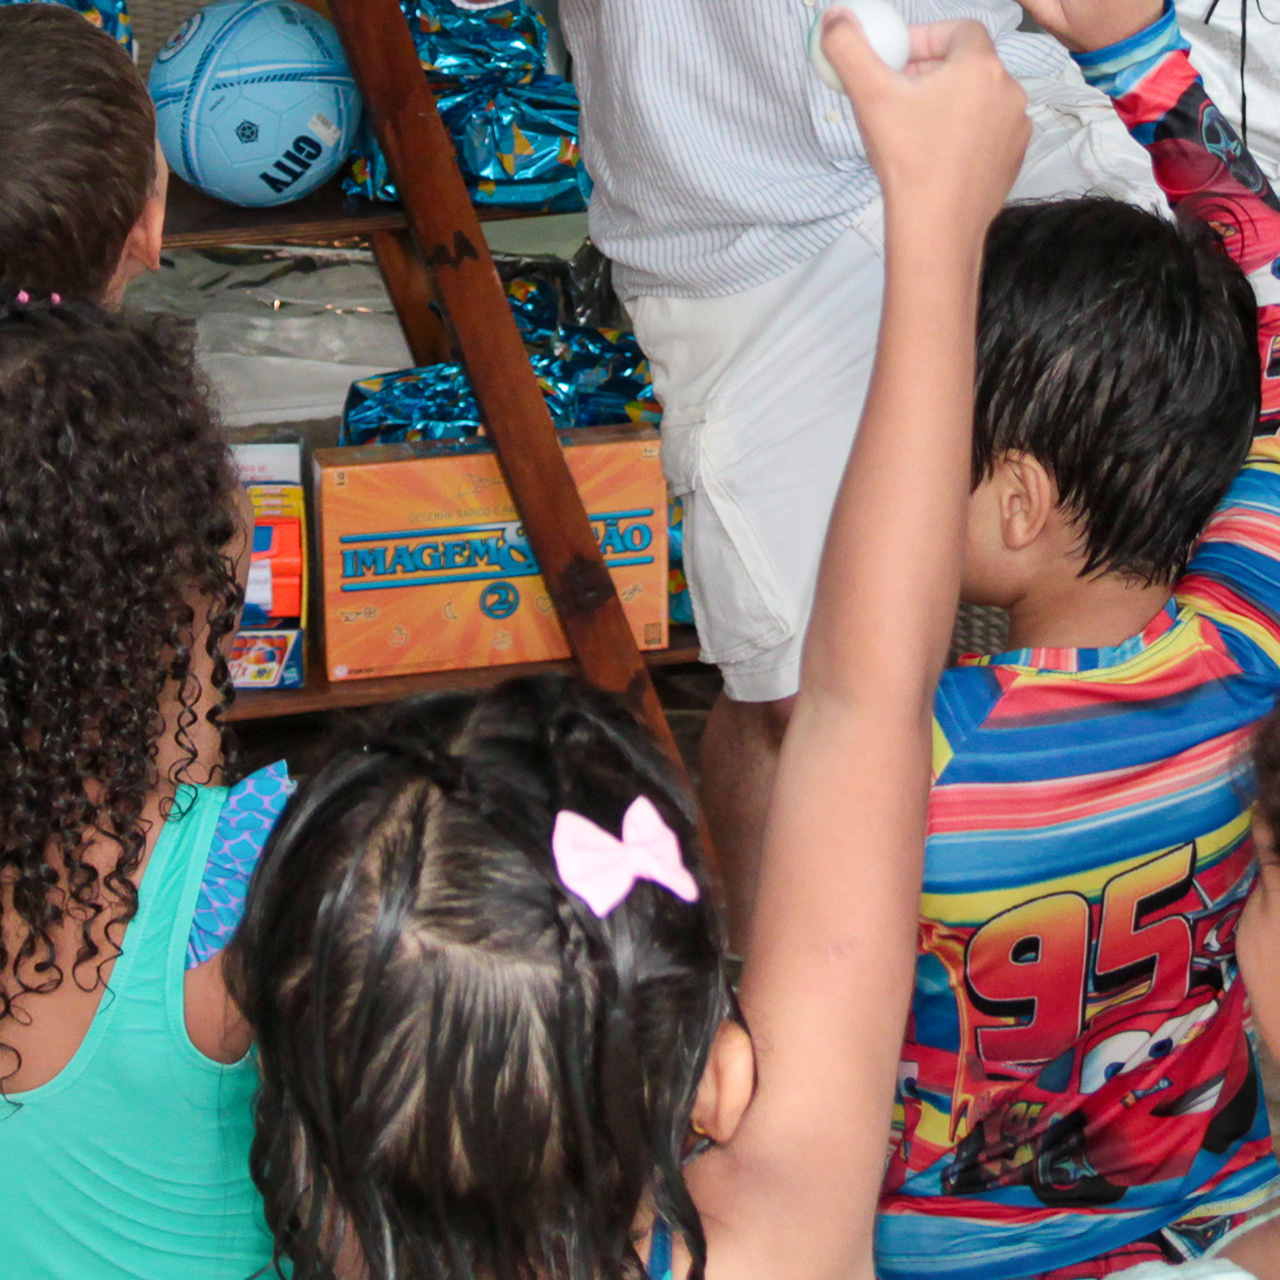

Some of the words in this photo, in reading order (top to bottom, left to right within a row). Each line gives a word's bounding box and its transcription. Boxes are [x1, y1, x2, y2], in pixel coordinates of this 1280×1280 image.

[258, 135, 322, 194] CITY
[340, 538, 499, 578] IMAGEM
[596, 519, 653, 555] ÃO
[489, 587, 512, 611] 2
[964, 839, 1197, 1076] 95
